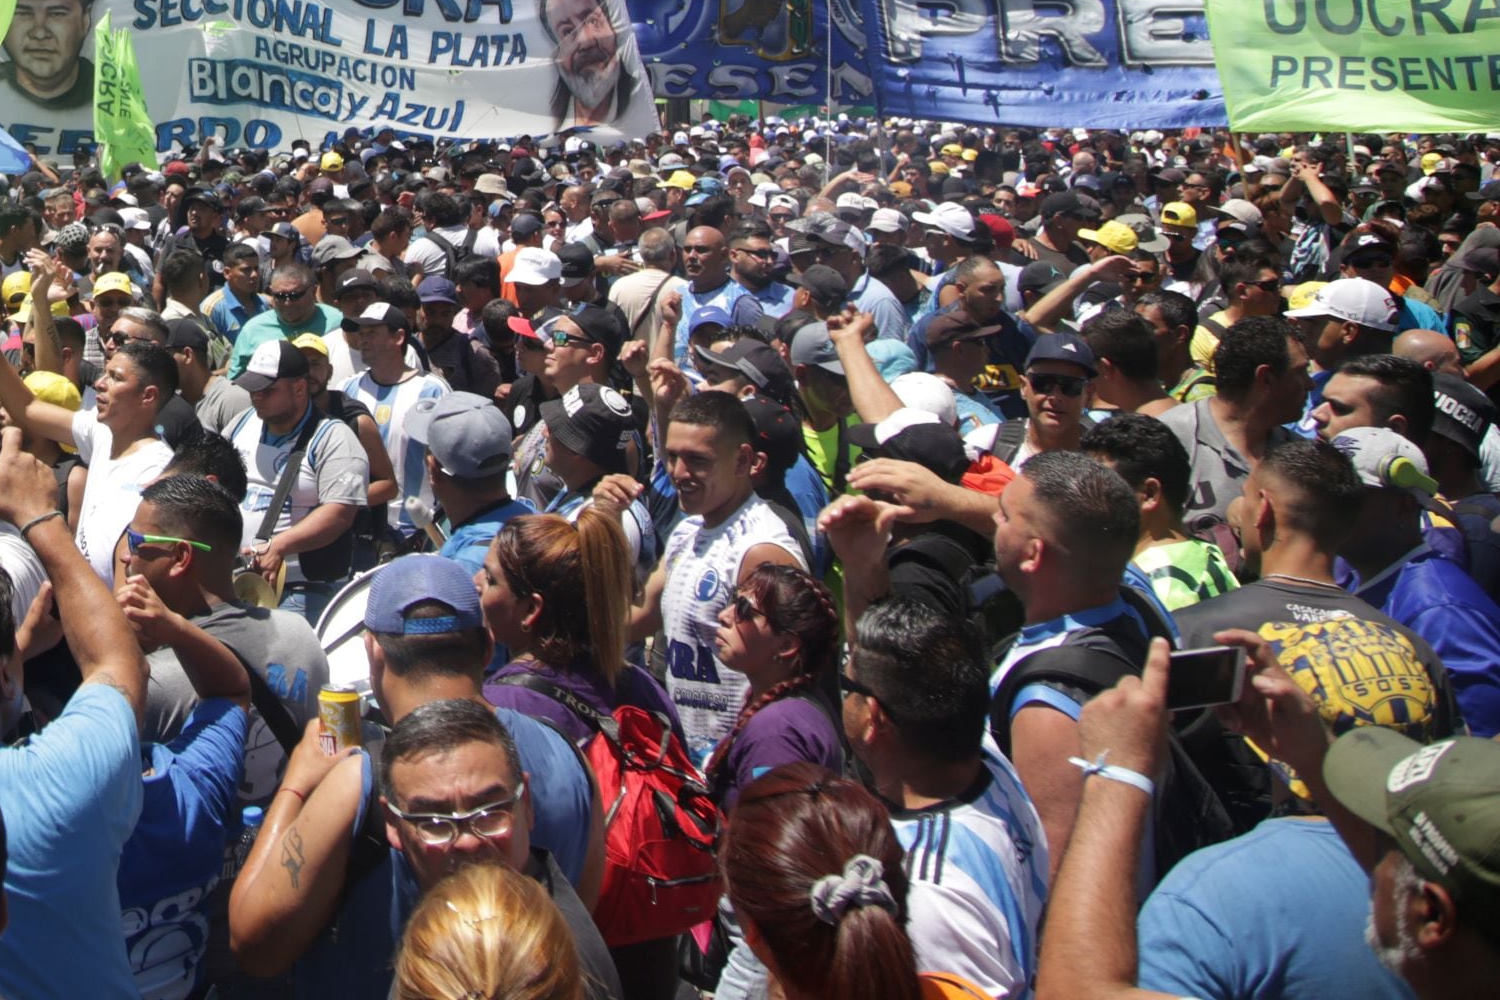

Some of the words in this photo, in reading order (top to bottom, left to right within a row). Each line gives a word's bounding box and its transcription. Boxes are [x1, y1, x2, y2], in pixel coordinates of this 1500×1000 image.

[255, 36, 416, 91] AGRUPACION
[365, 18, 409, 60] LA
[429, 31, 527, 67] PLATA
[190, 60, 343, 117] Blanca
[1270, 55, 1500, 92] PRESENTE
